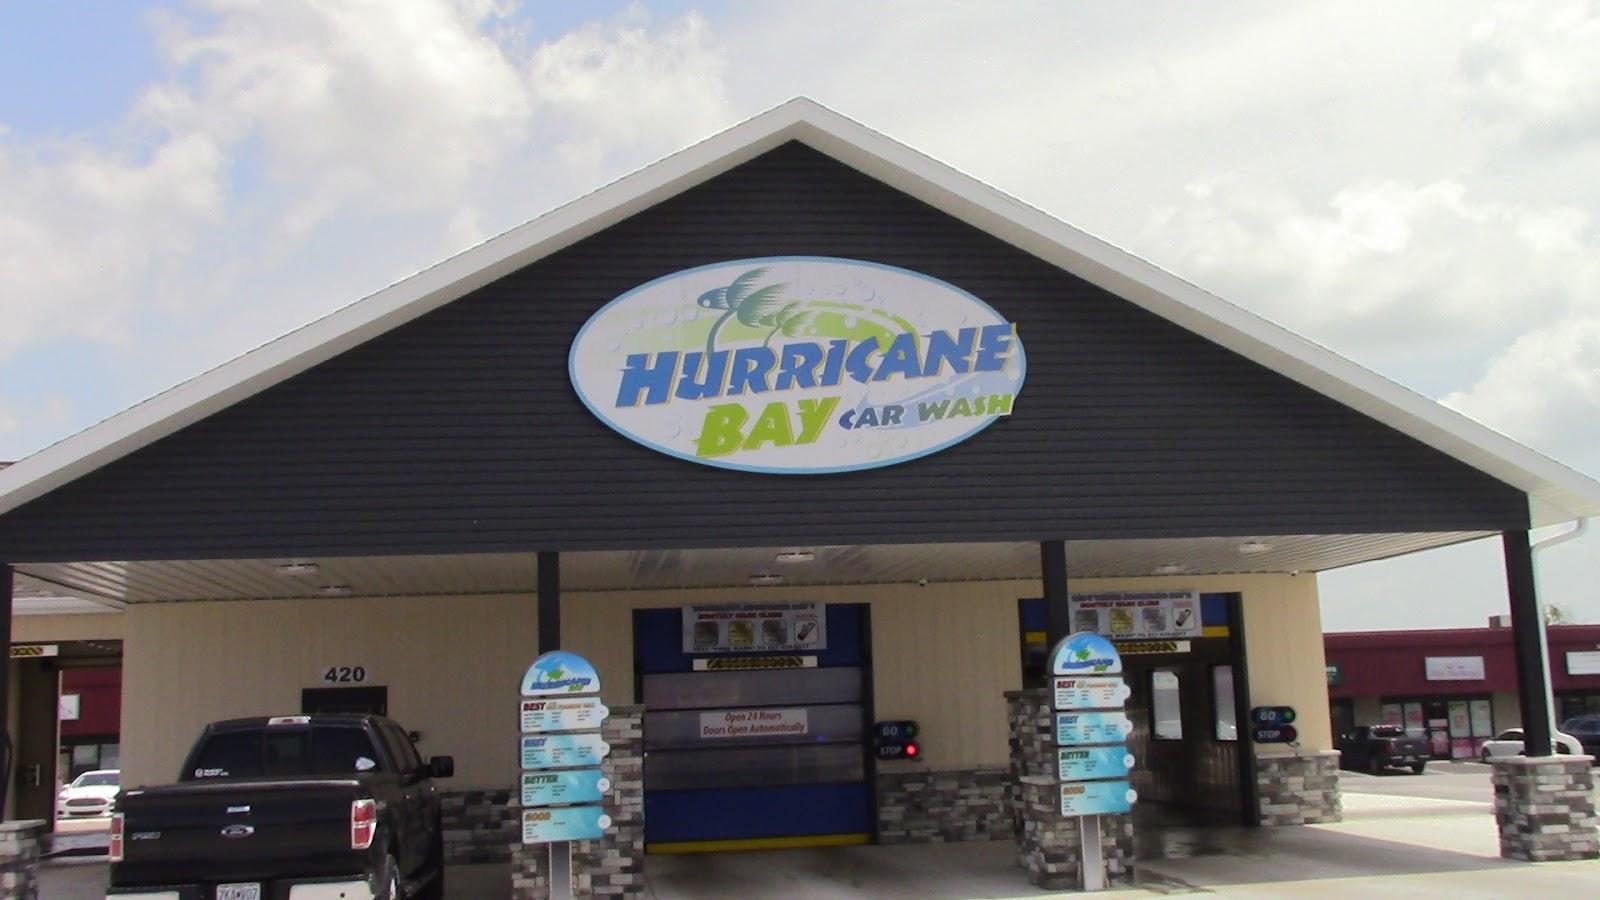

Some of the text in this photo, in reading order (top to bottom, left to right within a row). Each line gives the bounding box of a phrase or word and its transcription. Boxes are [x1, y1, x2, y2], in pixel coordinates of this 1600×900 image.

[615, 322, 1016, 408] HURRICANE
[839, 392, 1013, 430] CAR WASH
[696, 396, 841, 458] BAY
[325, 666, 366, 682] 420
[1056, 680, 1076, 689] BEST
[523, 702, 546, 711] BEST
[726, 711, 782, 723] Open 24 Hours
[704, 722, 805, 735] Doors Open Automatically
[1258, 730, 1280, 739] STOP
[880, 745, 902, 755] STOP
[524, 774, 559, 784] BETTER
